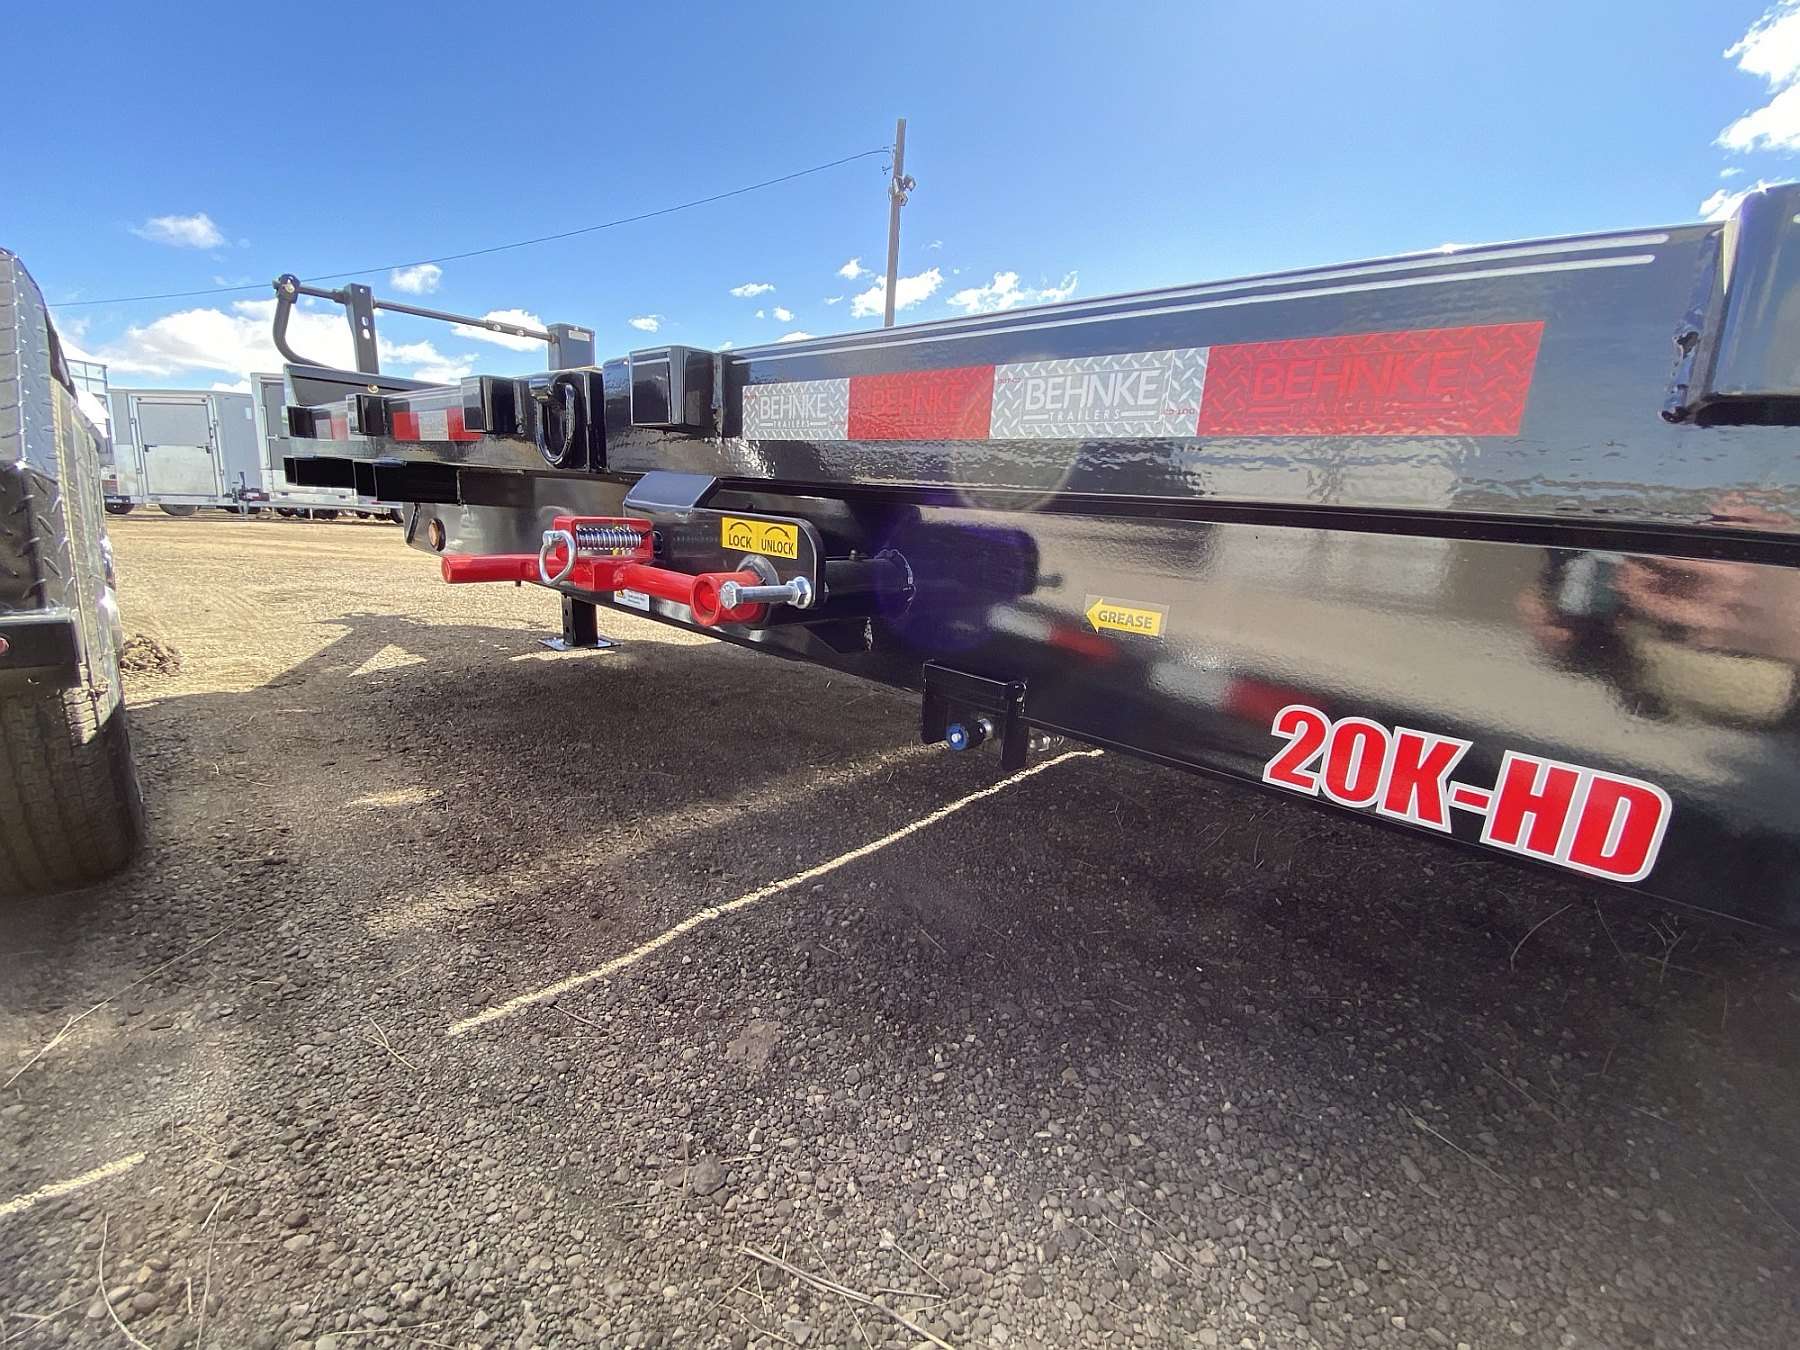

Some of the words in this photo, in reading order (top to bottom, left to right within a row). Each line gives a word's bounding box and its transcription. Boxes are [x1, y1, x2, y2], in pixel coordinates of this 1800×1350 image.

[1253, 350, 1468, 400] BEHNKE
[871, 381, 967, 417] BEHNKE
[1025, 368, 1162, 411] BEHNKE
[759, 392, 828, 420] BEHNKE
[1049, 408, 1121, 423] TRAILERS
[728, 533, 753, 549] LOCK
[761, 538, 794, 556] UNLOCK
[1098, 610, 1153, 629] GREASE
[1262, 704, 1672, 883] 20K-HD
